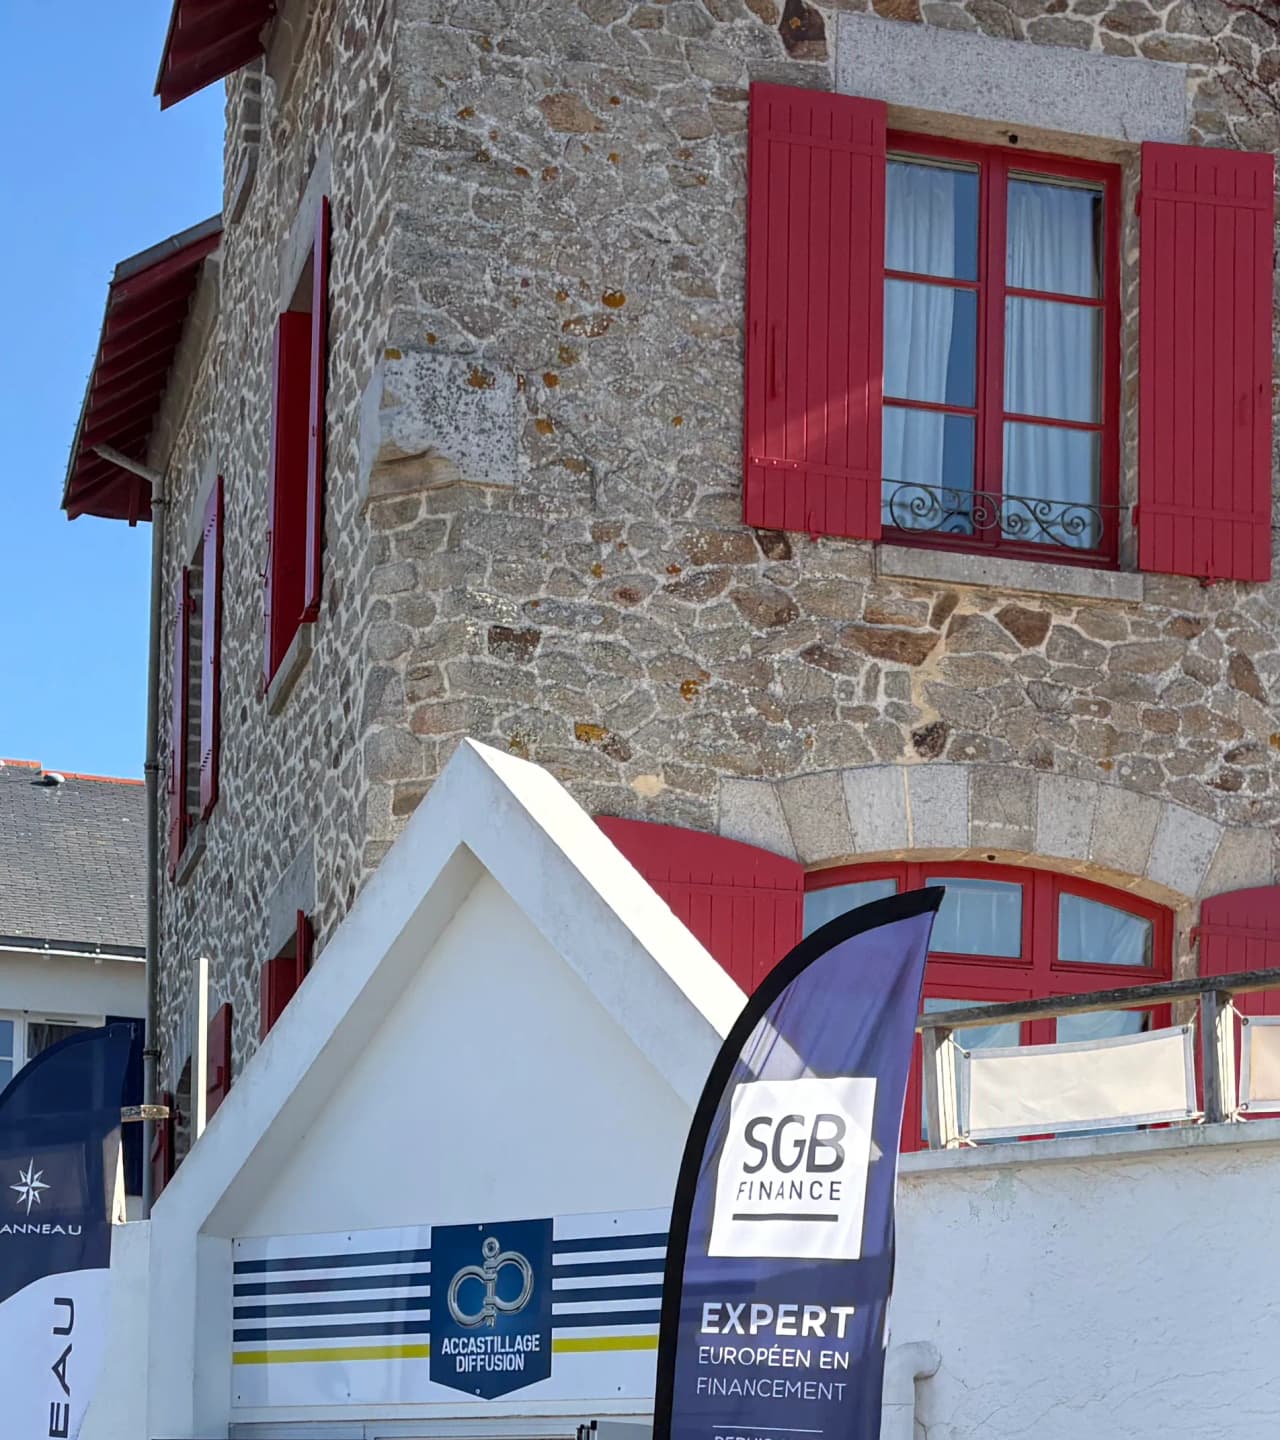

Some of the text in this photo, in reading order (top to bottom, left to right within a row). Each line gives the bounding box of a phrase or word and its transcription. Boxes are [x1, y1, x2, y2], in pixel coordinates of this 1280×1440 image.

[743, 1112, 847, 1174] SGB
[736, 1180, 842, 1201] FINANCE
[701, 1302, 854, 1338] EXPERT
[441, 1333, 541, 1355] ACCASTILLAGE
[698, 1343, 849, 1370] EUROPÉEN EN
[456, 1353, 524, 1372] DIFFUSION
[697, 1376, 847, 1401] FINANCEMENT
